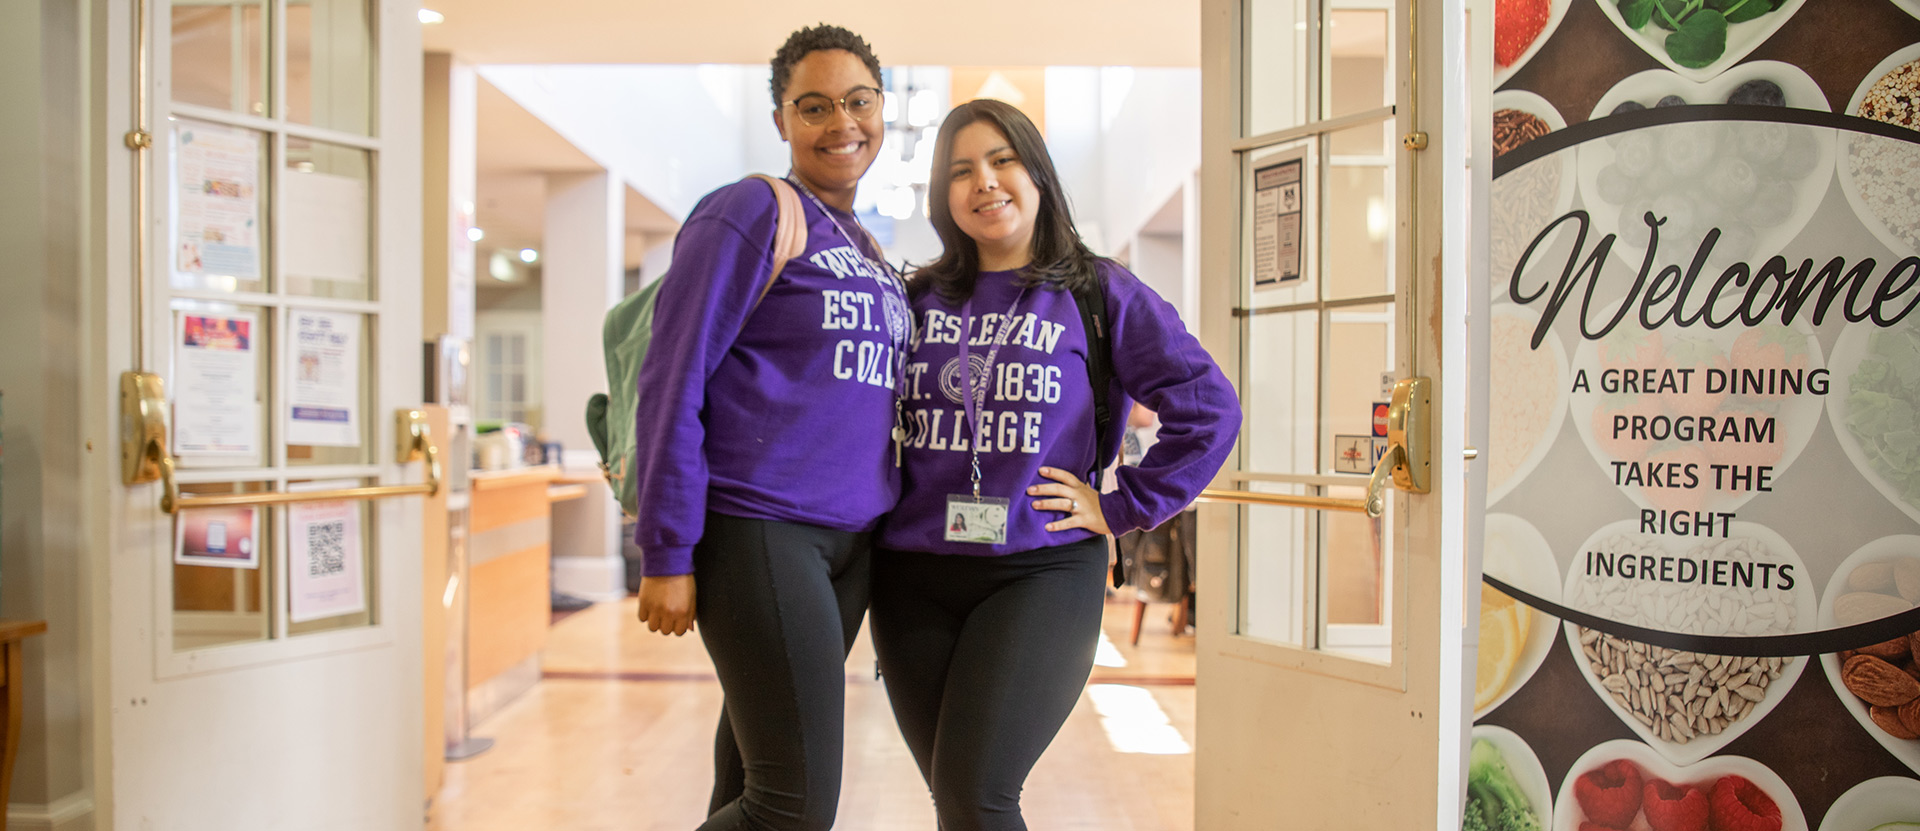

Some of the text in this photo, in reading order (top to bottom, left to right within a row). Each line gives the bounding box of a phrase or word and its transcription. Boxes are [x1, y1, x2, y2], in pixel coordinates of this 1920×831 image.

[1509, 209, 1920, 351] Welcome
[822, 289, 880, 332] EST.
[994, 362, 1062, 404] 1836
[1571, 368, 1830, 396] A GREAT DINING
[1612, 415, 1776, 443] PROGRAM
[1610, 461, 1774, 492] TAKES THE
[1639, 508, 1736, 539] RIGHT
[1585, 551, 1796, 591] INGREDIENTS
